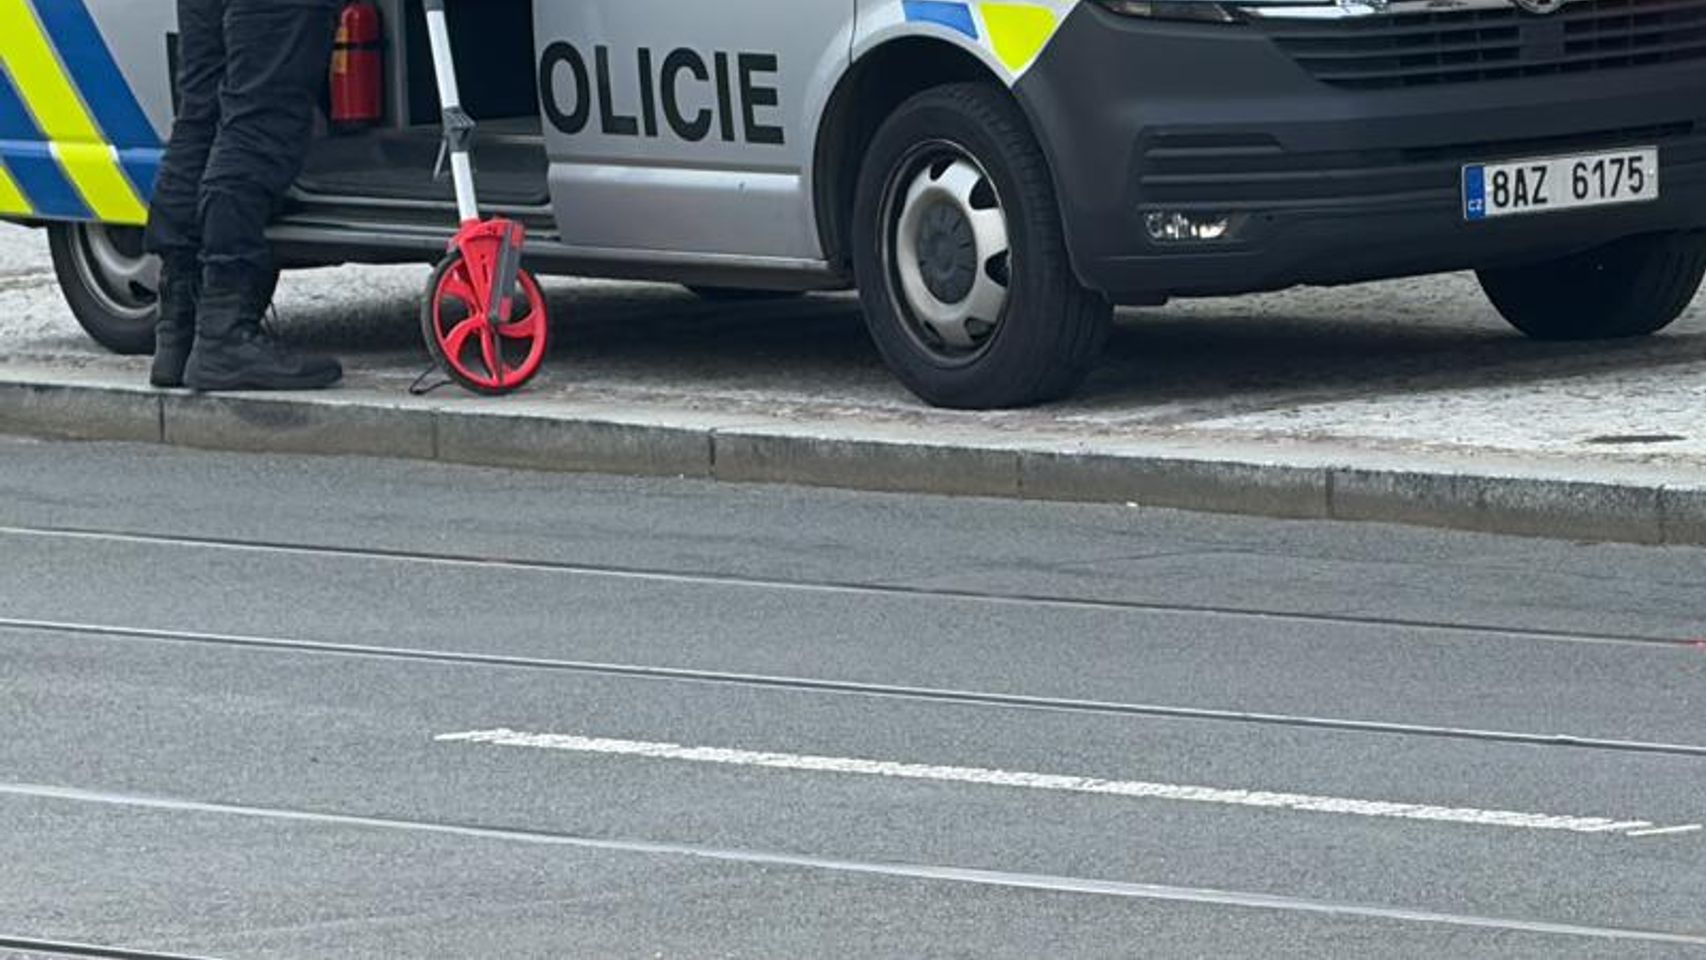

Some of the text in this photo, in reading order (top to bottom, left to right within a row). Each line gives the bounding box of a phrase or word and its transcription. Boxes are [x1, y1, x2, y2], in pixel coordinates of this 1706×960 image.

[1492, 156, 1644, 208] 8AZ 6175
[1468, 199, 1483, 211] CZ
